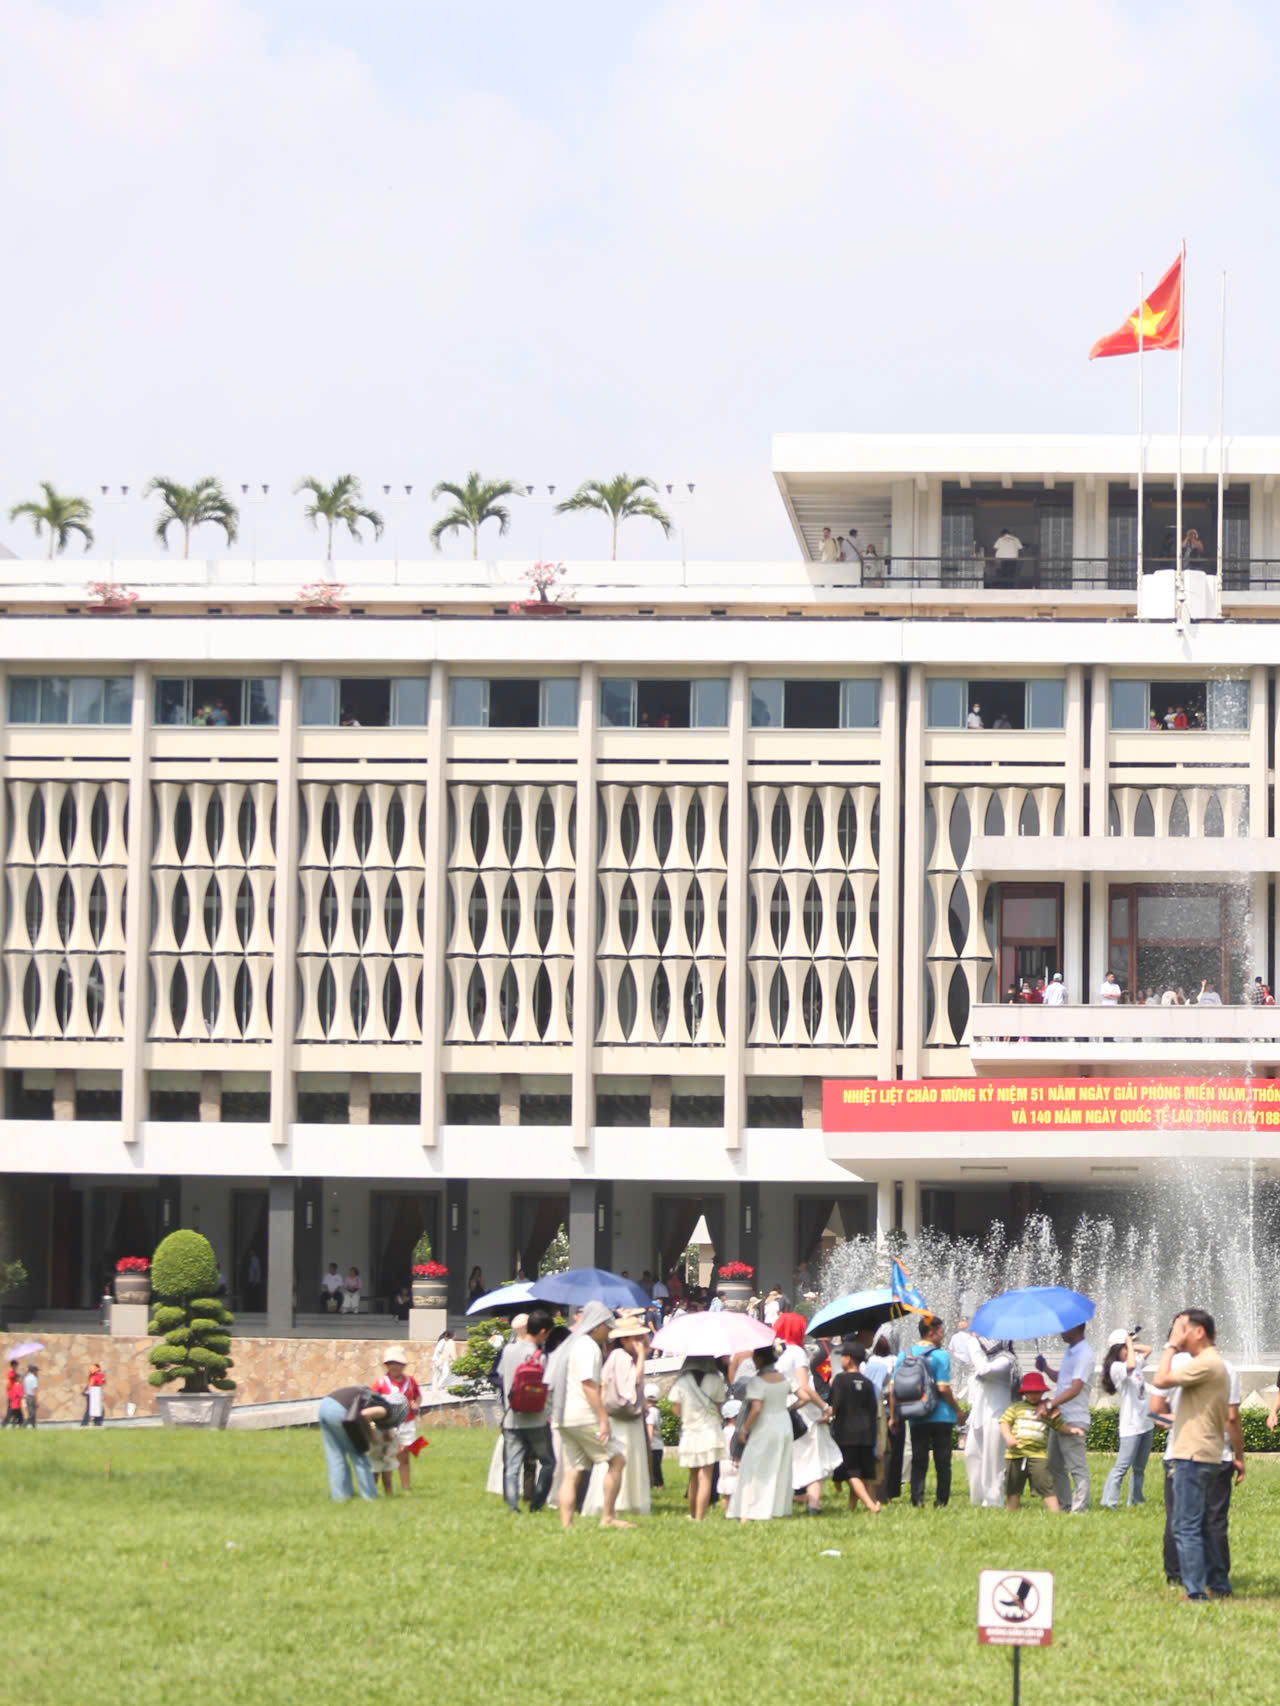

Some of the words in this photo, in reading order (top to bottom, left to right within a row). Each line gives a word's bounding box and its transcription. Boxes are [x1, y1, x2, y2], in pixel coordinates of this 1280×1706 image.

[843, 1086, 877, 1106] NHIỆT
[879, 1086, 904, 1106] LIỆT
[906, 1086, 938, 1103] CHÀO
[997, 1084, 1028, 1104] NIỆM
[1030, 1087, 1044, 1101] 51
[1047, 1084, 1076, 1101] NĂM
[1079, 1083, 1111, 1101] NGÀY
[1113, 1082, 1138, 1101] GIẢI
[1011, 1107, 1027, 1124] VÀ
[1030, 1110, 1052, 1124] 140
[1054, 1107, 1083, 1124] NĂM
[1085, 1106, 1117, 1124] NGÀY
[1120, 1105, 1151, 1125] QUỐC
[1171, 1109, 1194, 1123] LAO
